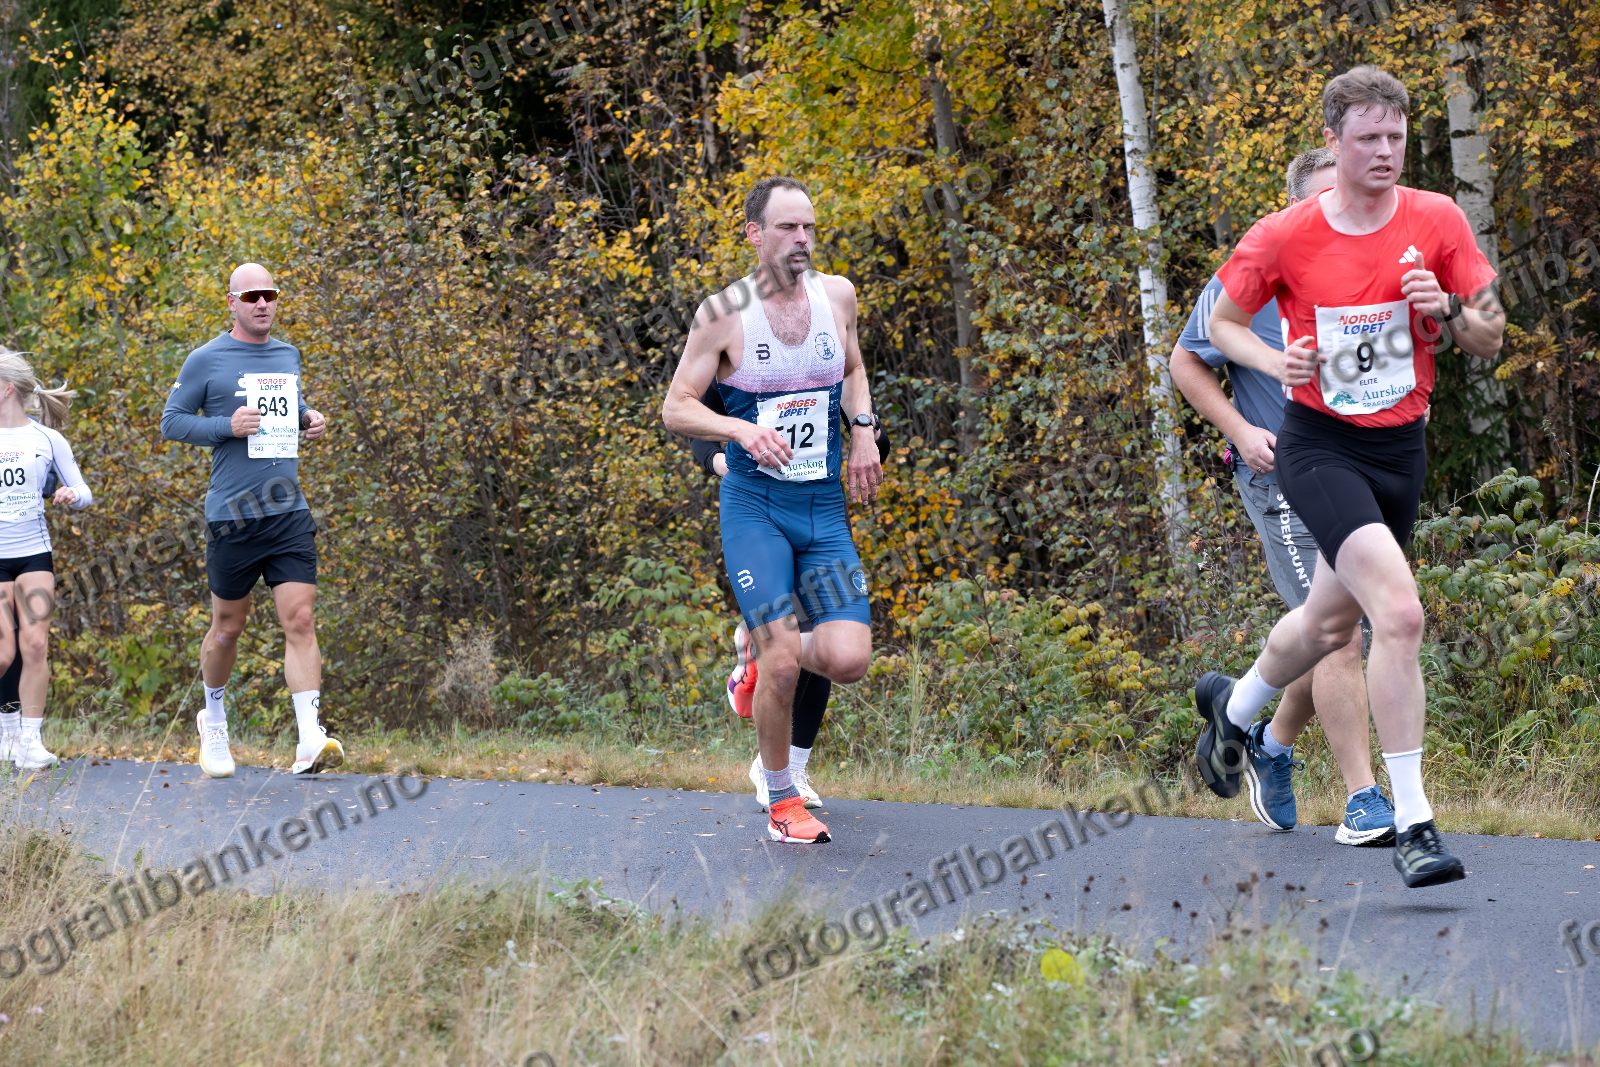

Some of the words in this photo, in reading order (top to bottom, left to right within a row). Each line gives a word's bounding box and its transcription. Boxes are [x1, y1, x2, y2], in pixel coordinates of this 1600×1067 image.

[1339, 311, 1392, 325] NORGES
[1344, 322, 1385, 335] LØPET
[1357, 342, 1374, 373] 9
[1360, 378, 1378, 386] ELITE
[1362, 384, 1412, 400] Aurskog
[257, 396, 288, 417] 643
[776, 398, 817, 411] NORGES
[779, 407, 809, 418] LØPET
[775, 422, 815, 449] 12
